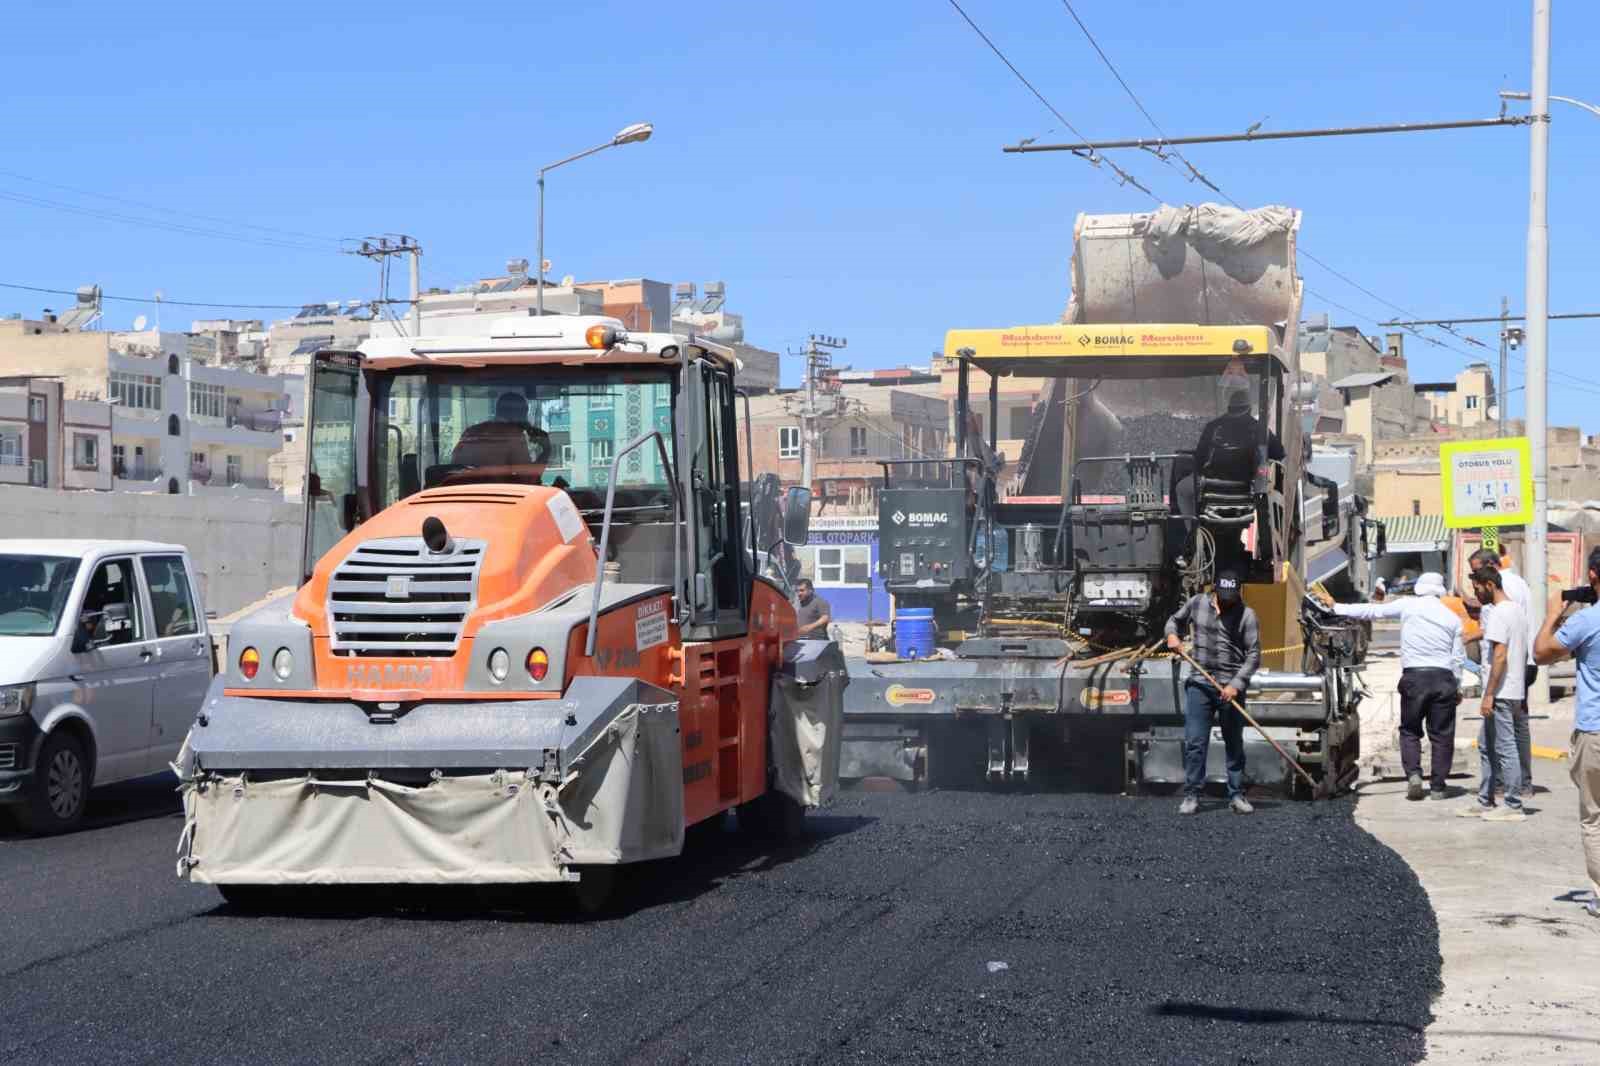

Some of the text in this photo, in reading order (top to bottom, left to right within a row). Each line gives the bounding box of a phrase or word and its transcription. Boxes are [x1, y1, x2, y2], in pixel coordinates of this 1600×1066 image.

[1094, 335, 1135, 345] BOMAG
[908, 512, 948, 523] BOMAG
[347, 665, 432, 686] HAMM
